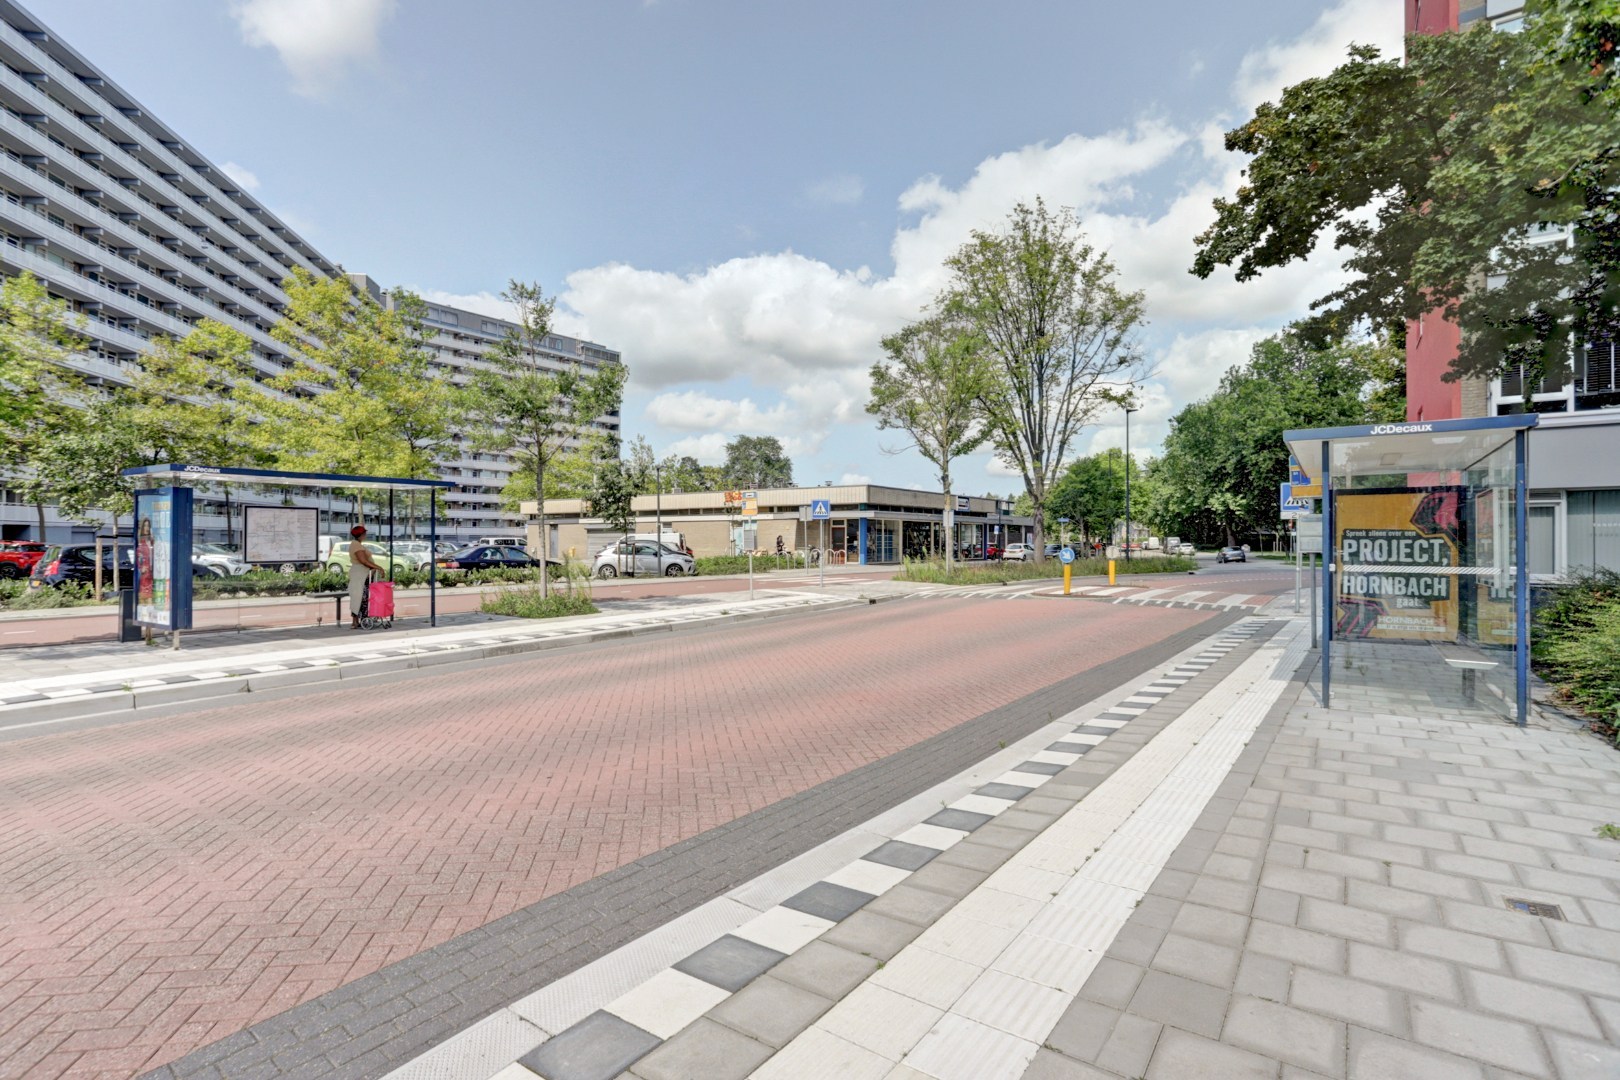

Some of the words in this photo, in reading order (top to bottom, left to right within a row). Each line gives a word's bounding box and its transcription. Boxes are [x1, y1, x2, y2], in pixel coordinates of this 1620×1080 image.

[1370, 424, 1432, 435] JCDecaux
[184, 465, 220, 473] JCDecaux
[1345, 530, 1366, 538] Spreek
[1342, 538, 1448, 566] PROJECT,
[1342, 575, 1447, 597] HORNBACH
[1377, 615, 1434, 625] HORNBACH
